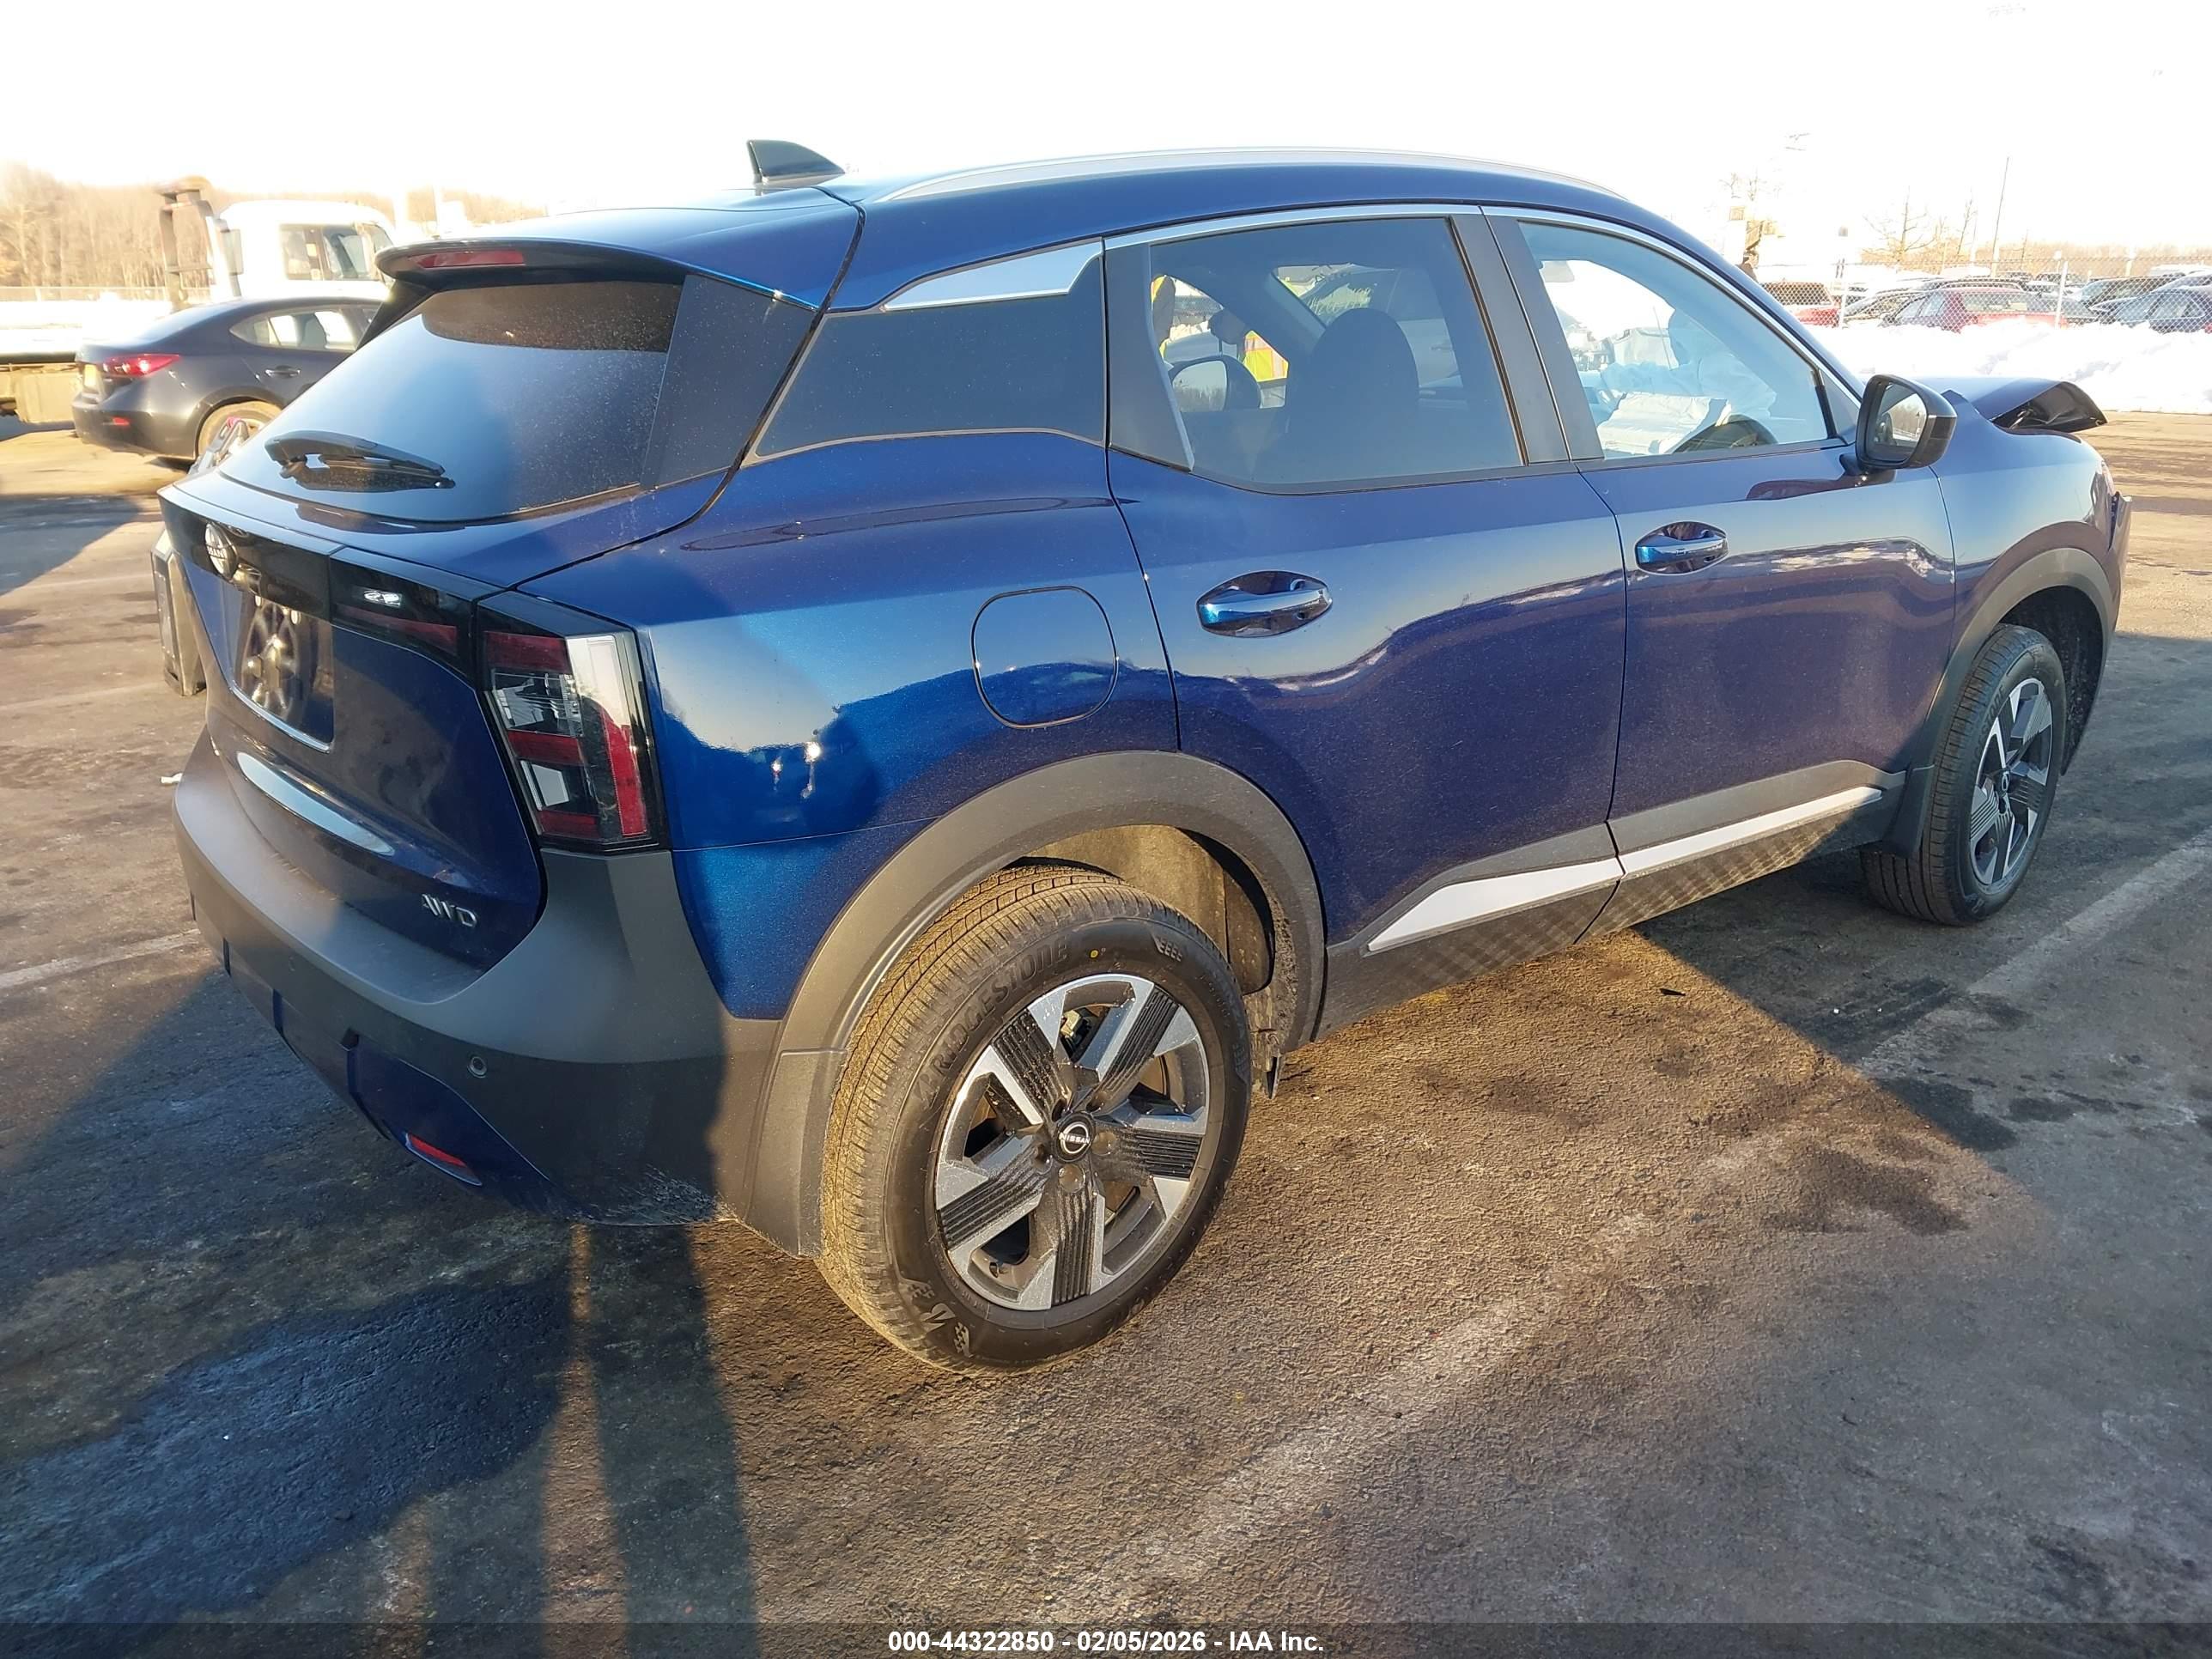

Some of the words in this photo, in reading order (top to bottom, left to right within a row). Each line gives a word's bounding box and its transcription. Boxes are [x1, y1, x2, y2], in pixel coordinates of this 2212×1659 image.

[422, 893, 477, 927] AWD
[914, 936, 1069, 1109] BRIDGESTONE
[1059, 1132, 1090, 1145] NISSAN
